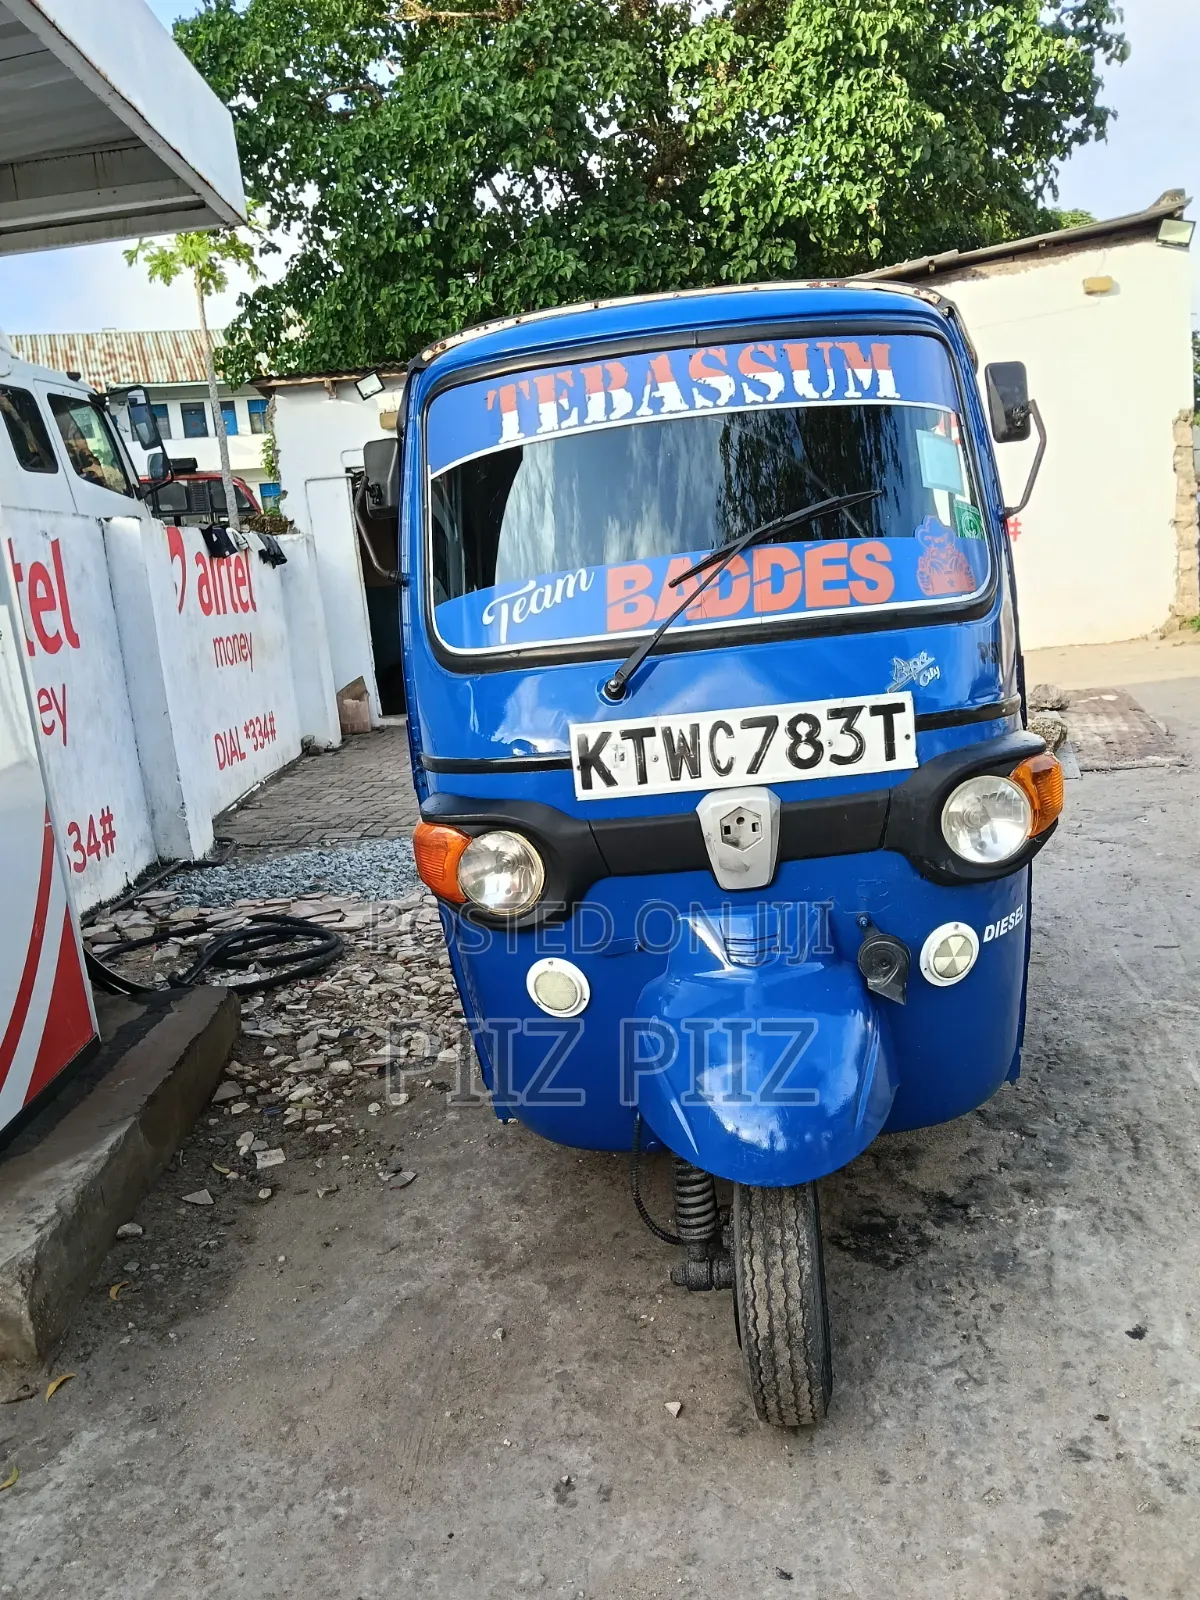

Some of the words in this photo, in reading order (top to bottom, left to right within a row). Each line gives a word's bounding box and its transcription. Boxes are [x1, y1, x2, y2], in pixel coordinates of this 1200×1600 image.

[486, 342, 901, 444] TEBASSUM
[195, 548, 258, 617] airtel
[482, 568, 595, 645] Team
[606, 541, 895, 632] BADDES
[213, 632, 253, 672] money
[214, 726, 247, 771] DIAL
[577, 702, 906, 790] KTWC783T
[66, 805, 117, 874] 34#
[983, 903, 1024, 943] DIESEL
